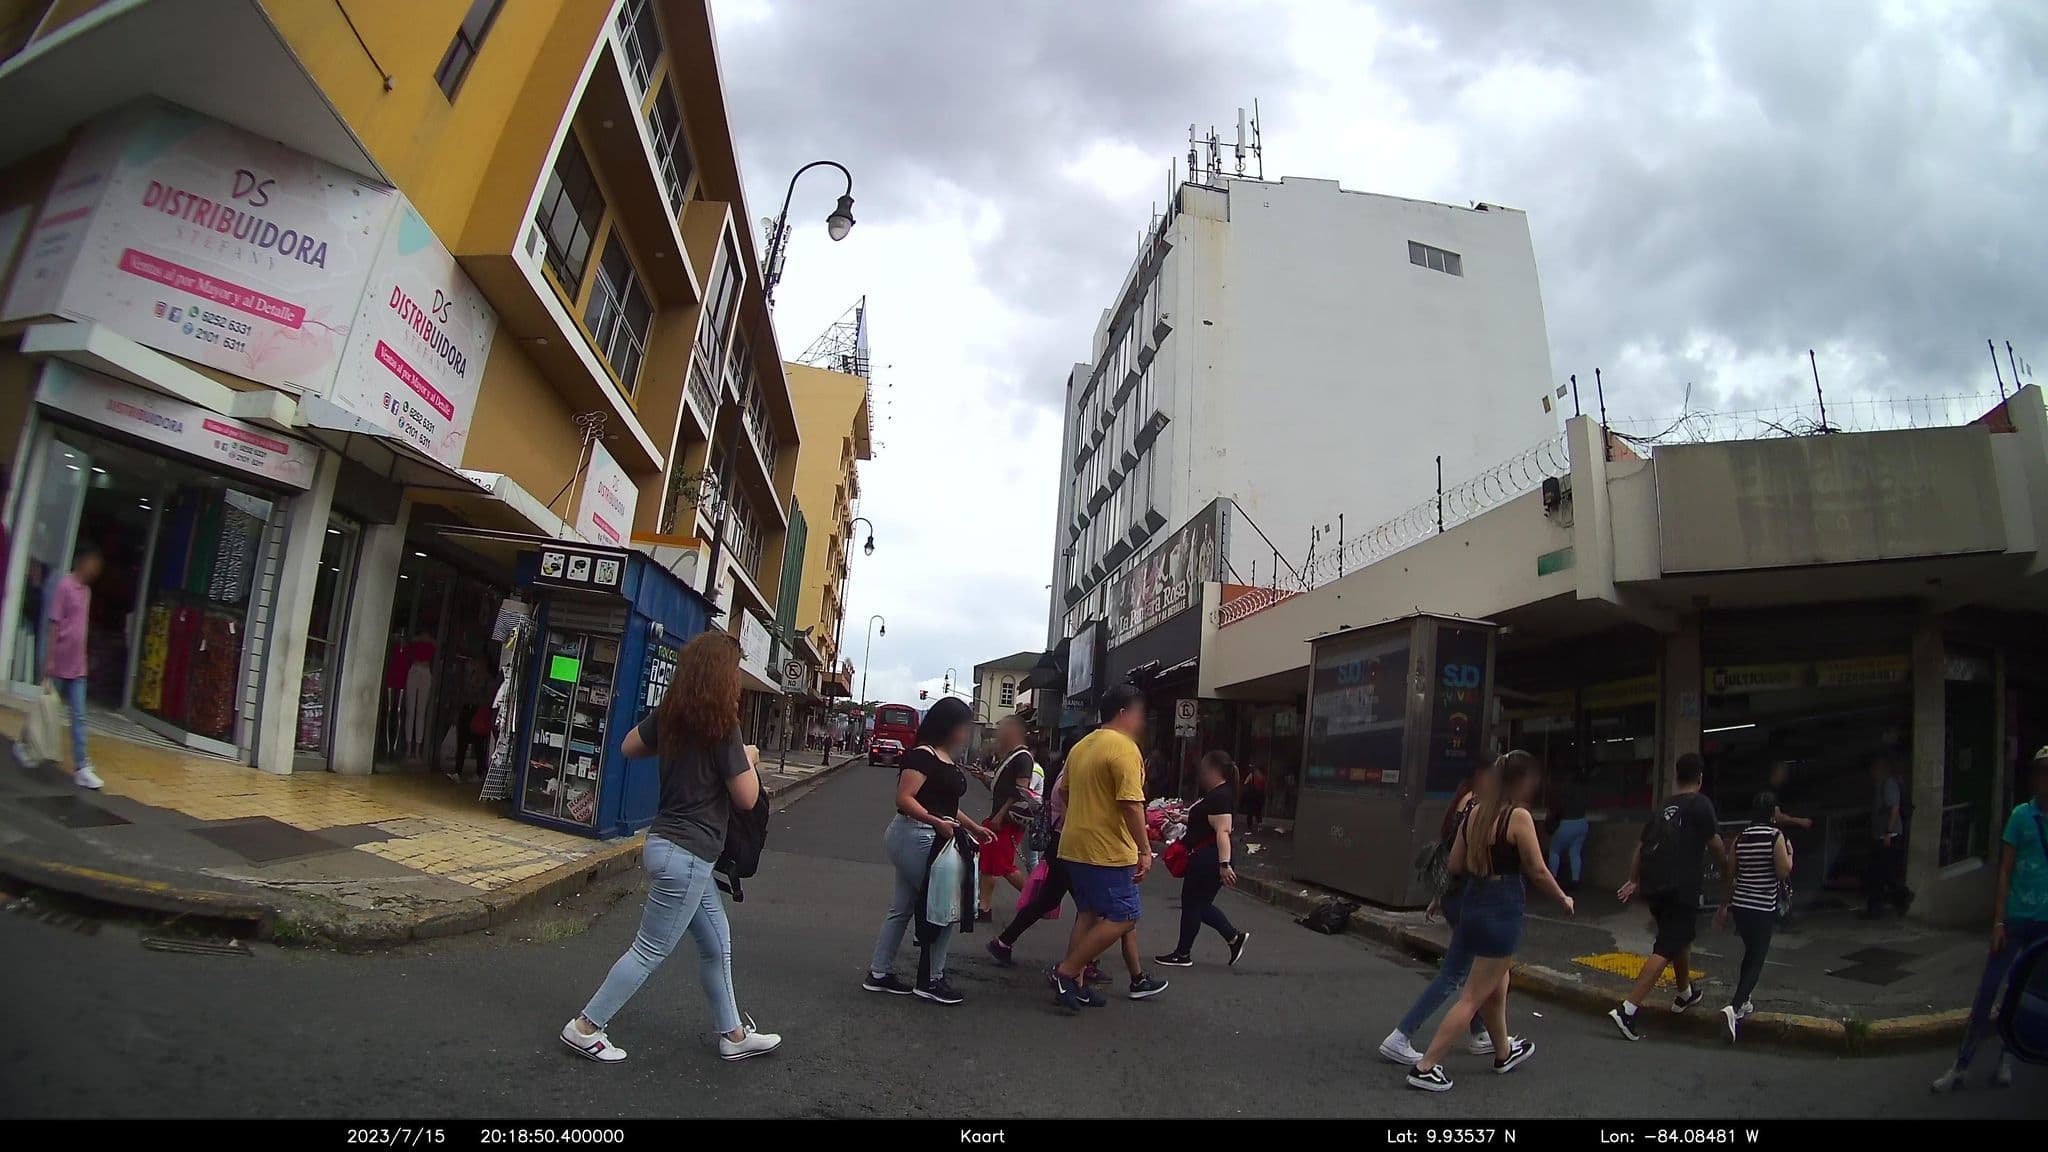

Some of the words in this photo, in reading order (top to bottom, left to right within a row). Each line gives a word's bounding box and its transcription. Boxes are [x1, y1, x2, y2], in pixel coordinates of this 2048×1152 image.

[232, 169, 275, 207] DS
[143, 180, 328, 269] DISTRIBUIDORA
[199, 277, 233, 304] Mayor
[231, 293, 241, 306] y
[243, 293, 254, 308] al
[256, 297, 297, 322] Detalle
[432, 289, 452, 324] DS
[195, 328, 219, 344] 2101
[223, 337, 246, 353] 6311
[228, 320, 252, 336] 6331
[389, 285, 467, 379] DISTRIBUIDORA
[405, 423, 418, 438] 2101
[422, 418, 435, 434] 6331
[1119, 616, 1129, 634] La
[1162, 579, 1187, 609] Rosa
